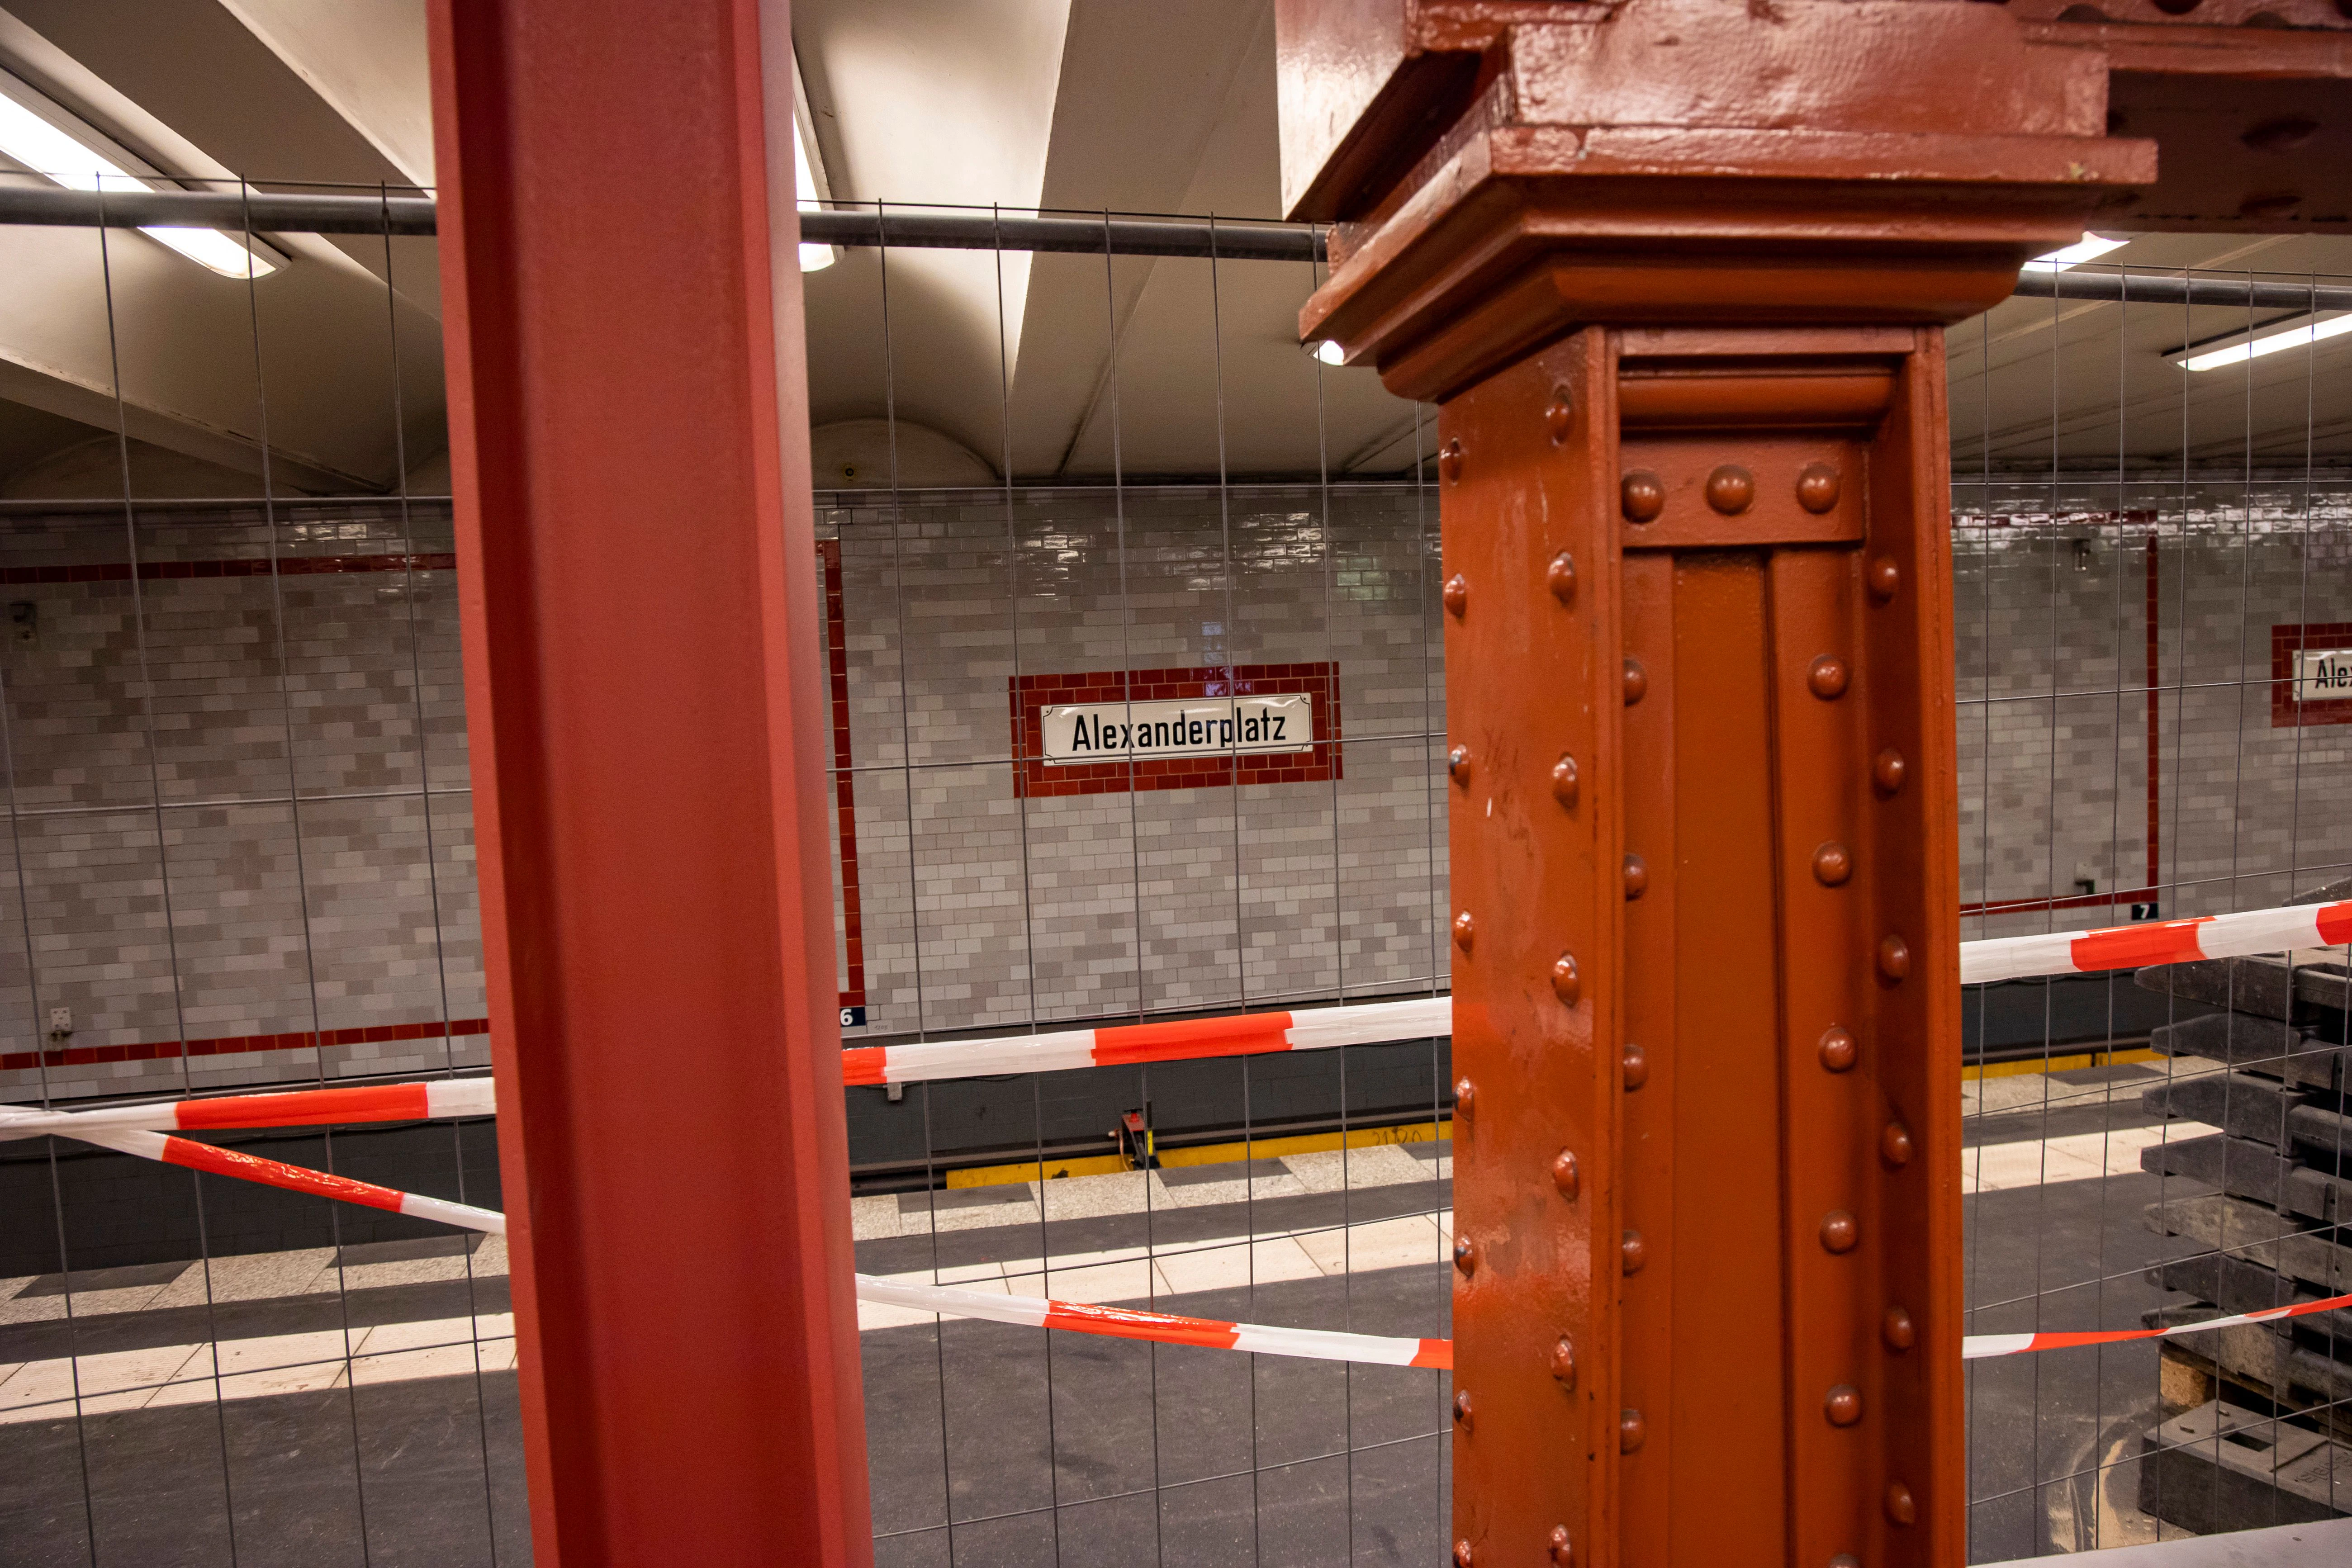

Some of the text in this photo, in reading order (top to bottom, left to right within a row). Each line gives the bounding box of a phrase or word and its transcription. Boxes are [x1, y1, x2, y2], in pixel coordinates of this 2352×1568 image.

[2314, 658, 2352, 688] Ale
[1072, 706, 1286, 751] Alexanderplatz
[2140, 905, 2150, 919] 7
[840, 1009, 854, 1026] 6
